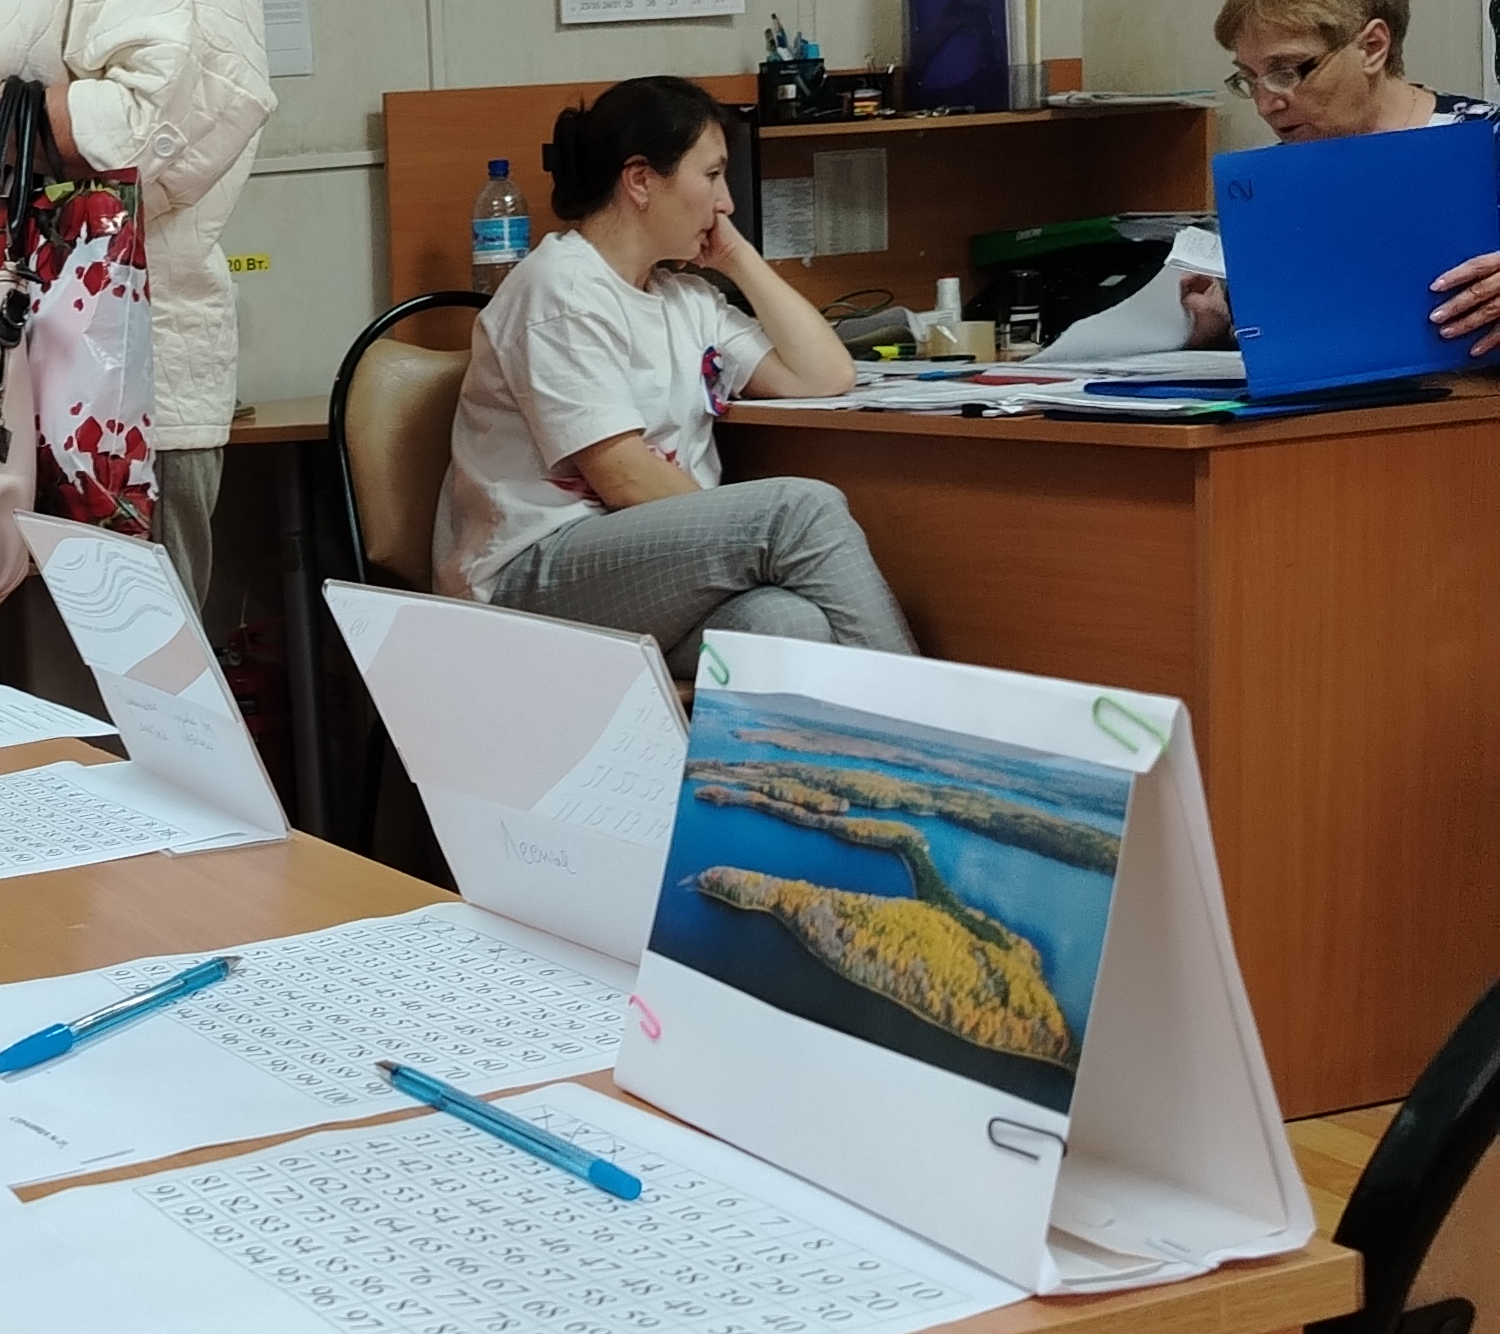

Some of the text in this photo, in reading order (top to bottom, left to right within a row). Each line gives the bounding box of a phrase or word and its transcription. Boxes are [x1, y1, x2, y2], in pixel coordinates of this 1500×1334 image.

[247, 258, 268, 271] Вт.
[174, 1008, 357, 1104] 94 95 96 97 98 99 100
[205, 1002, 391, 1094] 84 85 86 87 88 89 90
[148, 1185, 184, 1202] 91
[177, 1206, 213, 1223] 92
[207, 1225, 244, 1242] 93
[238, 1246, 276, 1264] 94
[272, 1267, 311, 1282] 95
[308, 1286, 341, 1306] 96
[340, 1309, 383, 1328] 97
[236, 1165, 272, 1181] 71
[266, 1185, 303, 1200] 72
[297, 1205, 335, 1222] 73
[330, 1225, 369, 1243] 74
[365, 1245, 405, 1263] 75
[399, 1265, 438, 1285] 76
[437, 1288, 481, 1305] 77
[476, 1311, 520, 1331] 78
[320, 1148, 358, 1163] 51
[350, 1166, 390, 1183] 52
[382, 1186, 424, 1202] 53
[416, 1207, 459, 1222] 54
[452, 1227, 497, 1242] 55
[488, 1247, 528, 1263] 56
[539, 1267, 576, 1282] 57
[568, 1288, 616, 1305] 58
[611, 1310, 660, 1327] 59
[640, 1163, 943, 1299] 4 5 6 7 8 9 10
[667, 1205, 898, 1310] 16 17 18 19 20
